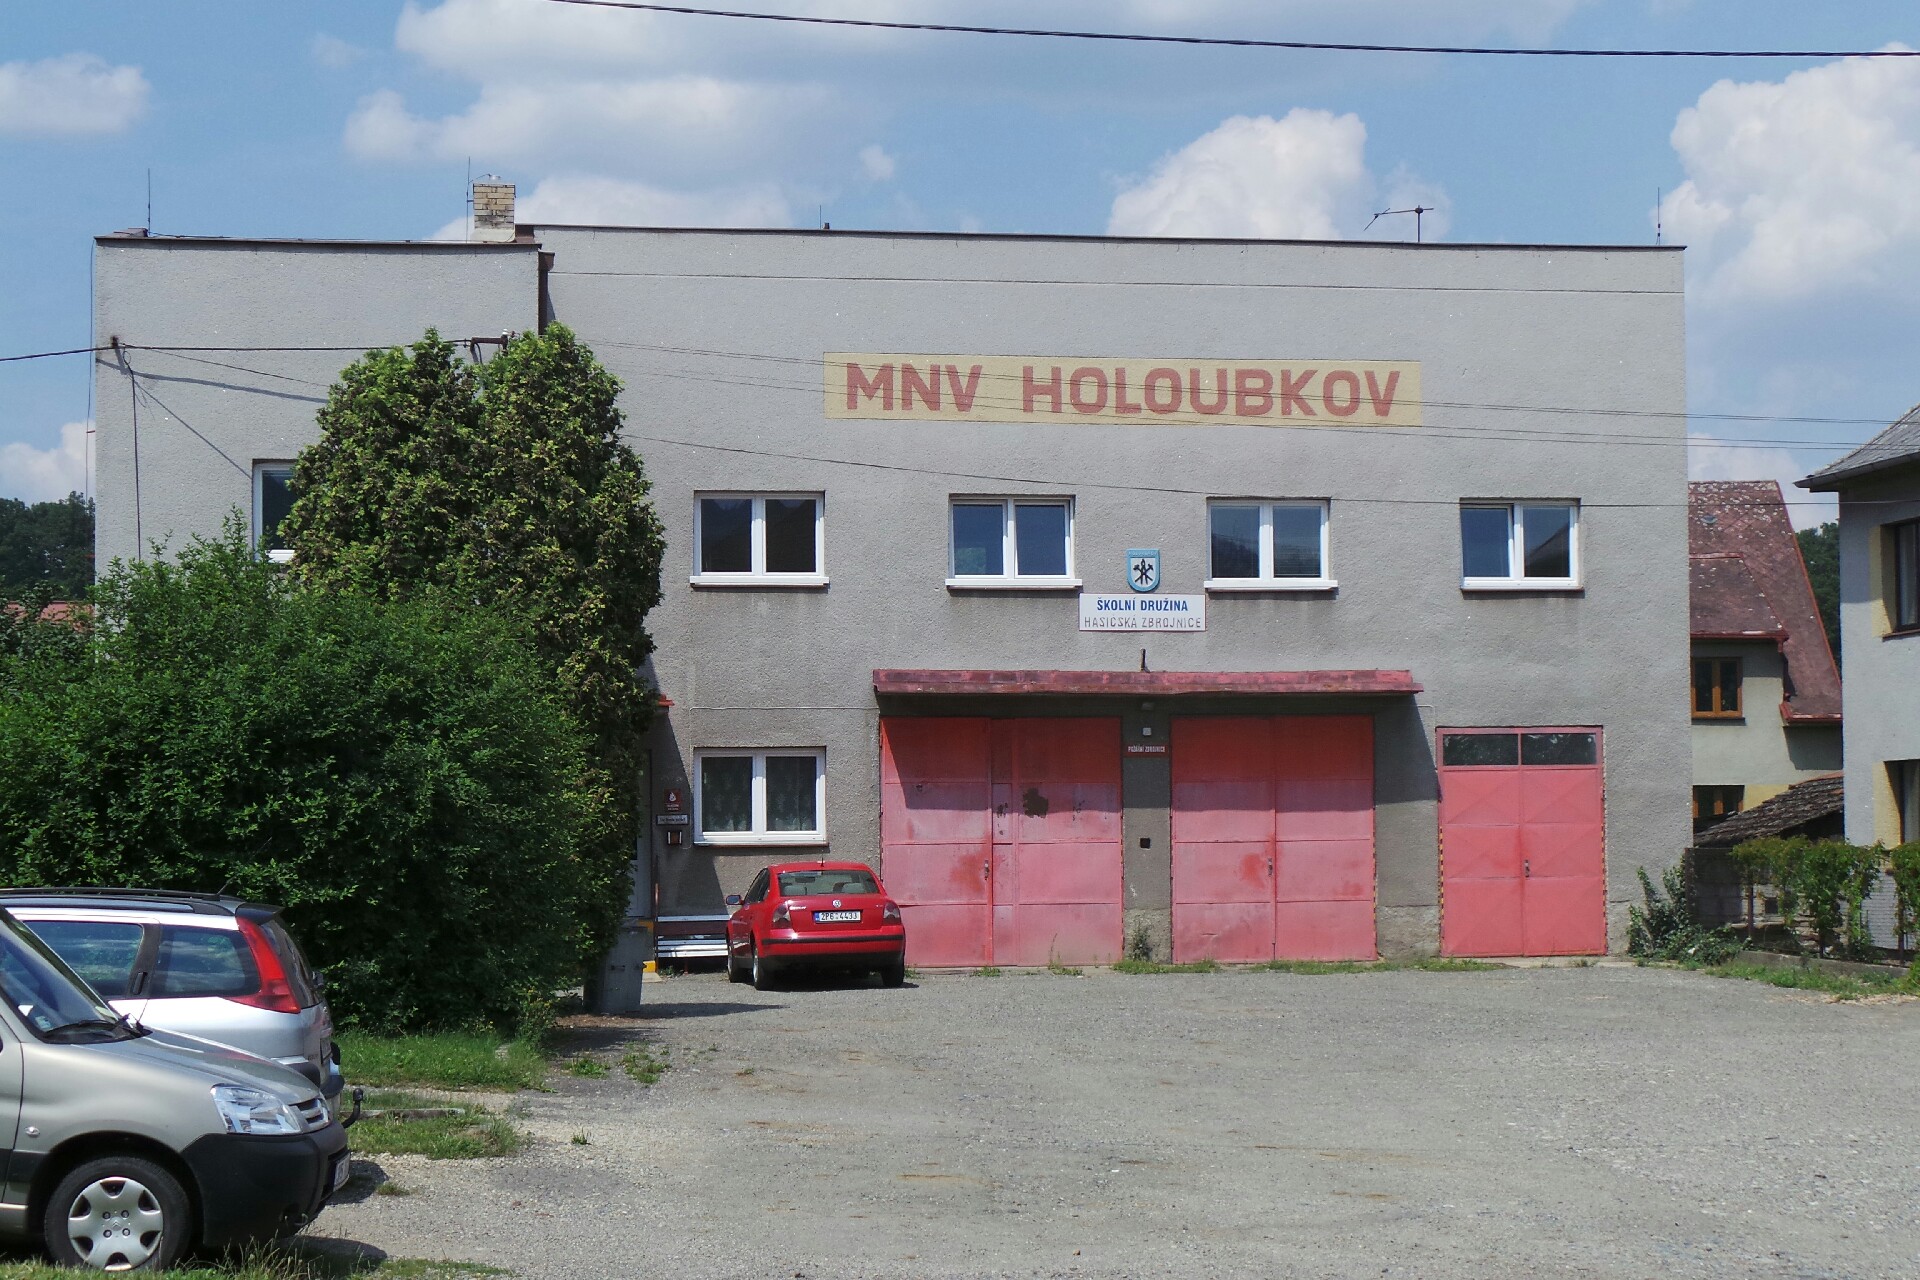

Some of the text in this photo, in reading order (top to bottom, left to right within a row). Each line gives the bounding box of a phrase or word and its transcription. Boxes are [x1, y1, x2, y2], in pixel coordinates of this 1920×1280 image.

[846, 361, 1400, 418] MNV HOLOUBKOV
[1097, 597, 1188, 611] ŠKOLNÍ DRUŽINA
[1141, 616, 1201, 628] ZBROJNICE
